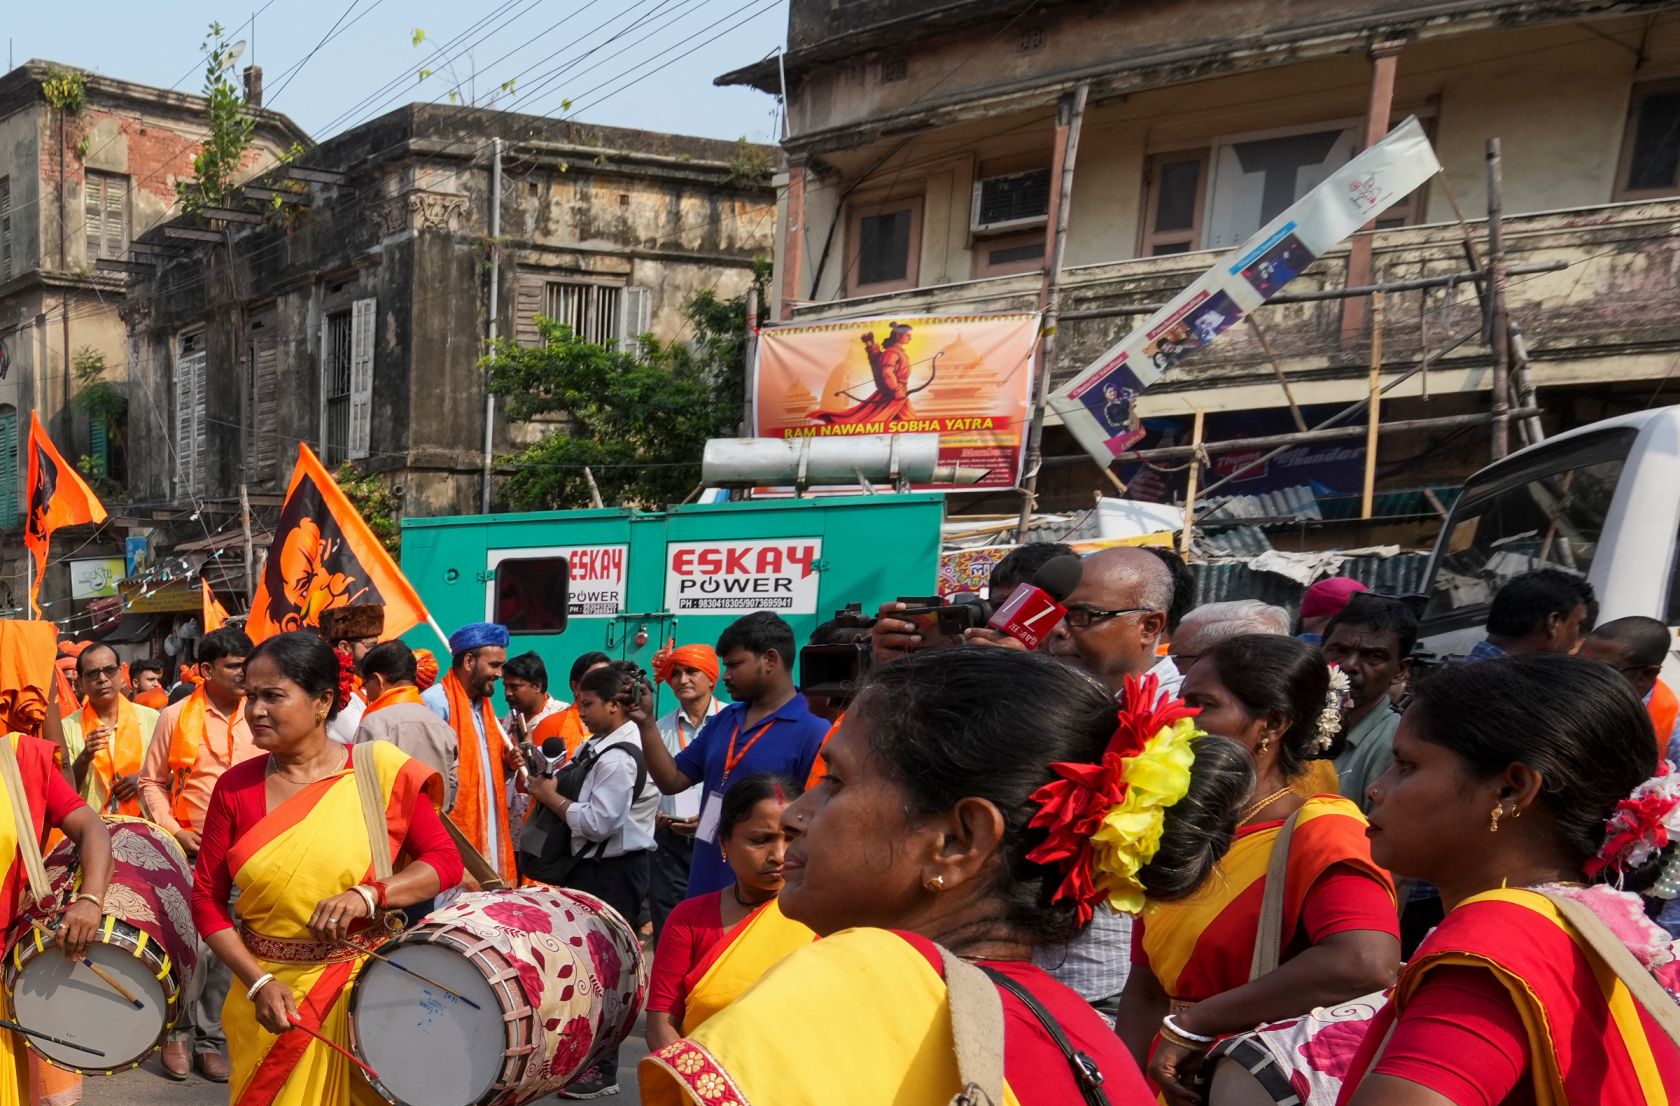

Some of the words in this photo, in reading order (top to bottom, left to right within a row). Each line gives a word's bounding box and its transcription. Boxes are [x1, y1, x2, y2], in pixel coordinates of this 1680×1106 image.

[784, 428, 816, 440] RAM
[820, 422, 884, 436] NAWAMI
[888, 420, 940, 433] SOBHA
[945, 418, 993, 431] YATRA
[570, 549, 623, 586] ESKAY
[672, 546, 815, 580] ESKAY
[680, 576, 793, 594] POWER
[569, 590, 619, 603] POWER
[1023, 599, 1056, 632] Z
[1009, 622, 1020, 633] ZEE
